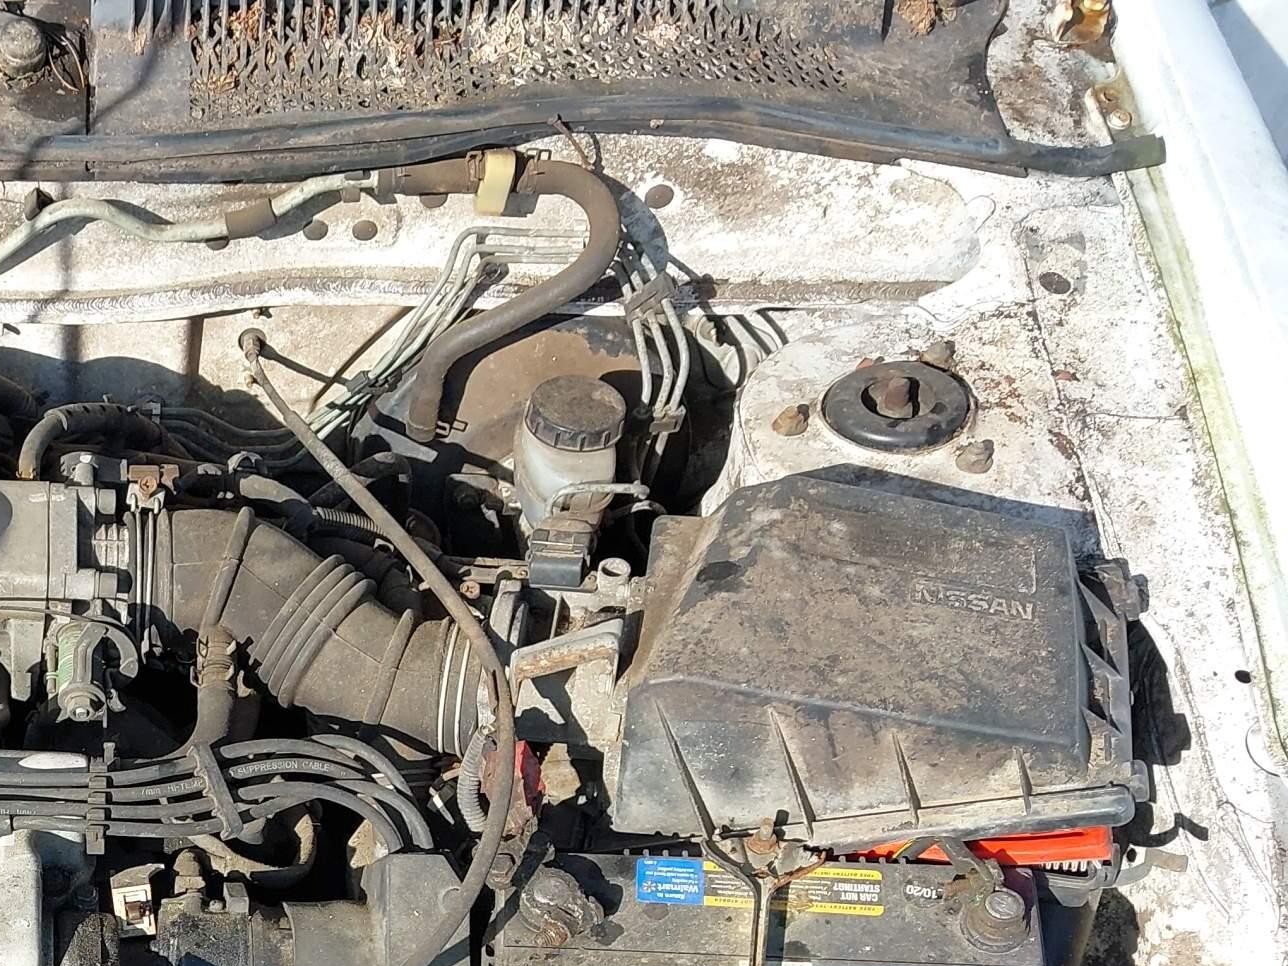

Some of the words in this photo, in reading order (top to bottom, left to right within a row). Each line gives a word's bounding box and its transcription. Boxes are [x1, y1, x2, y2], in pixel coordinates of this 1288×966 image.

[910, 583, 1034, 621] NISSAN
[237, 761, 298, 777] SUPPRESSION
[656, 882, 699, 894] Walmart
[859, 893, 879, 902] CAR
